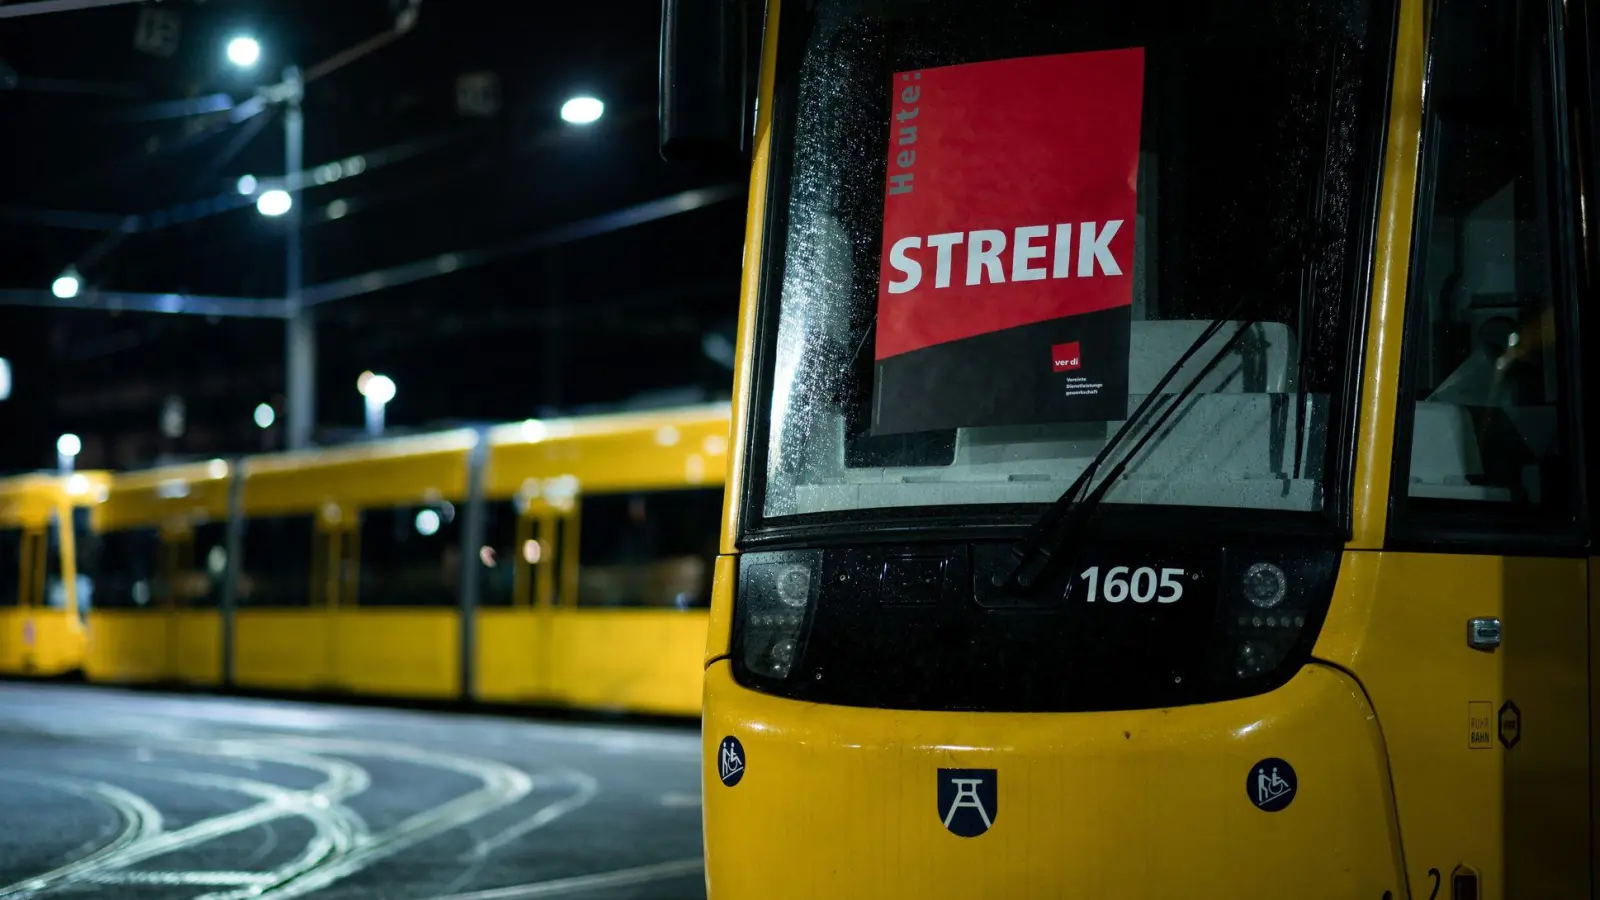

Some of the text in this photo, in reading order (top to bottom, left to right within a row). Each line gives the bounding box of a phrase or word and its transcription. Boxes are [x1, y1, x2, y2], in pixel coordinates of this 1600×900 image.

[888, 72, 921, 196] Heute:
[888, 219, 1125, 294] STREIK
[1080, 566, 1184, 604] 1605
[1471, 731, 1490, 743] BAHN
